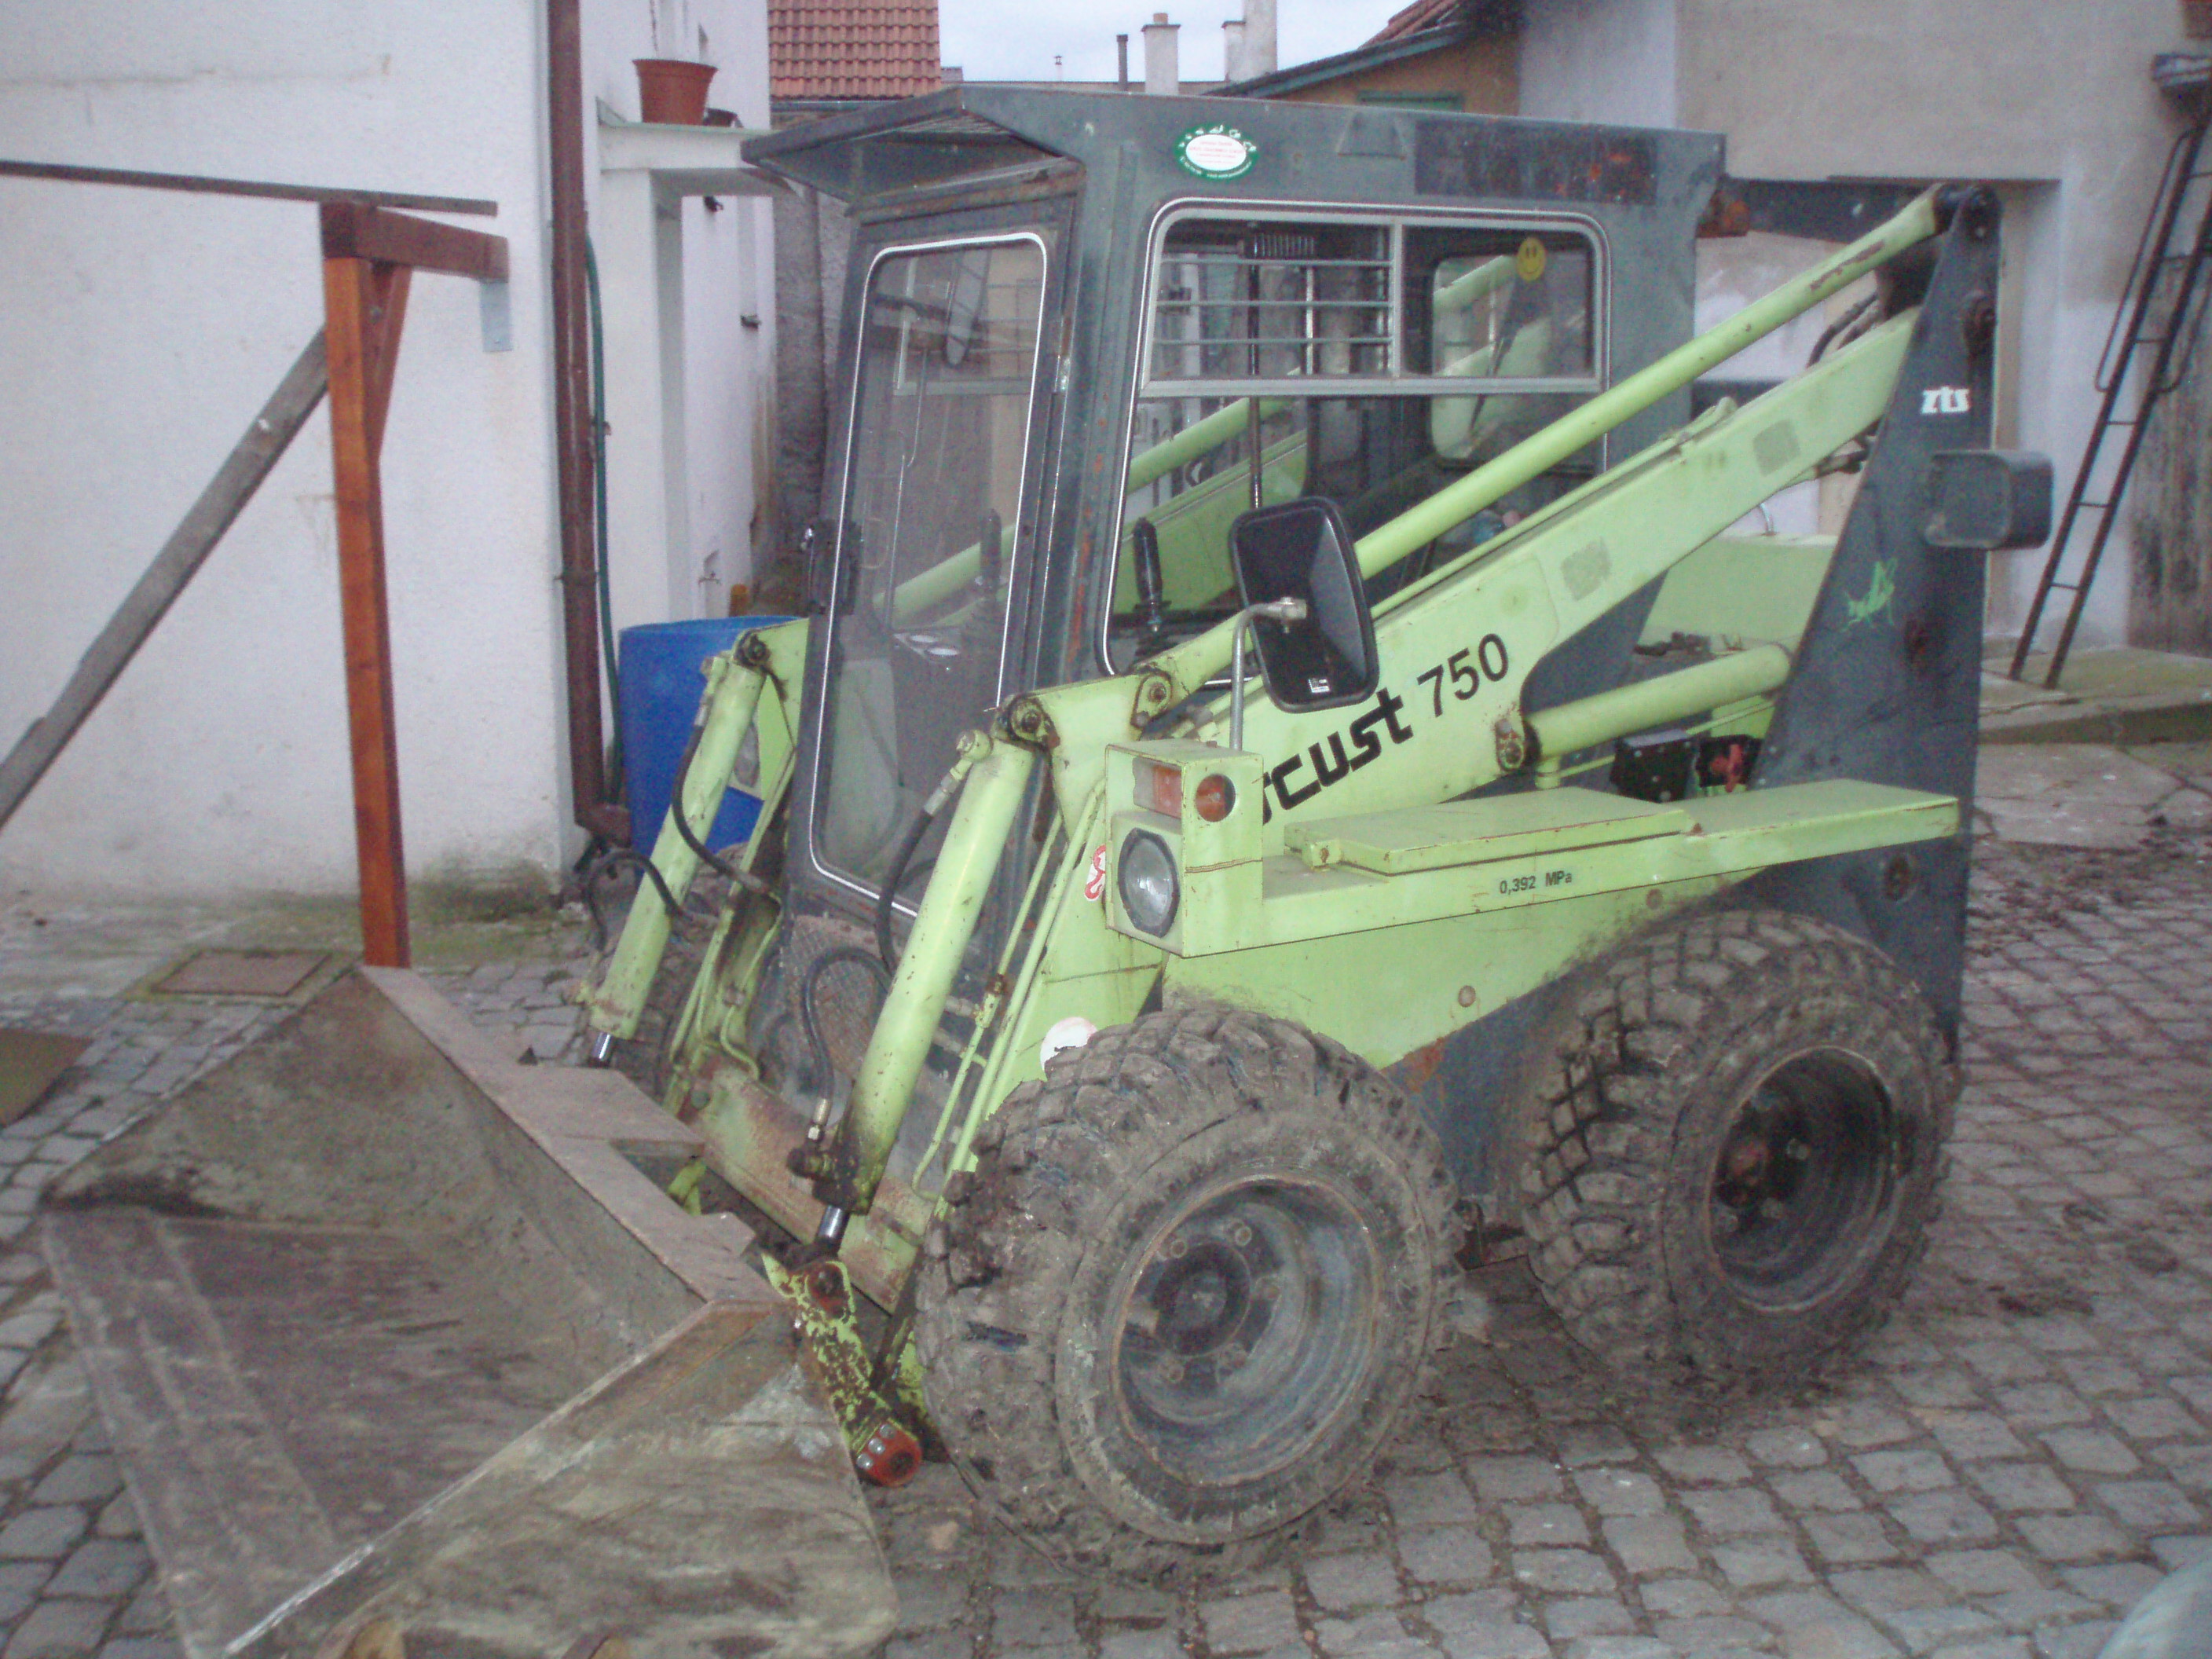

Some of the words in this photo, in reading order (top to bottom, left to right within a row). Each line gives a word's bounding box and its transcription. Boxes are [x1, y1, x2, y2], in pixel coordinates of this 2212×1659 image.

[1417, 633, 1508, 717] 750
[1500, 875, 1536, 895] 0,392
[1545, 870, 1573, 887] MPa
